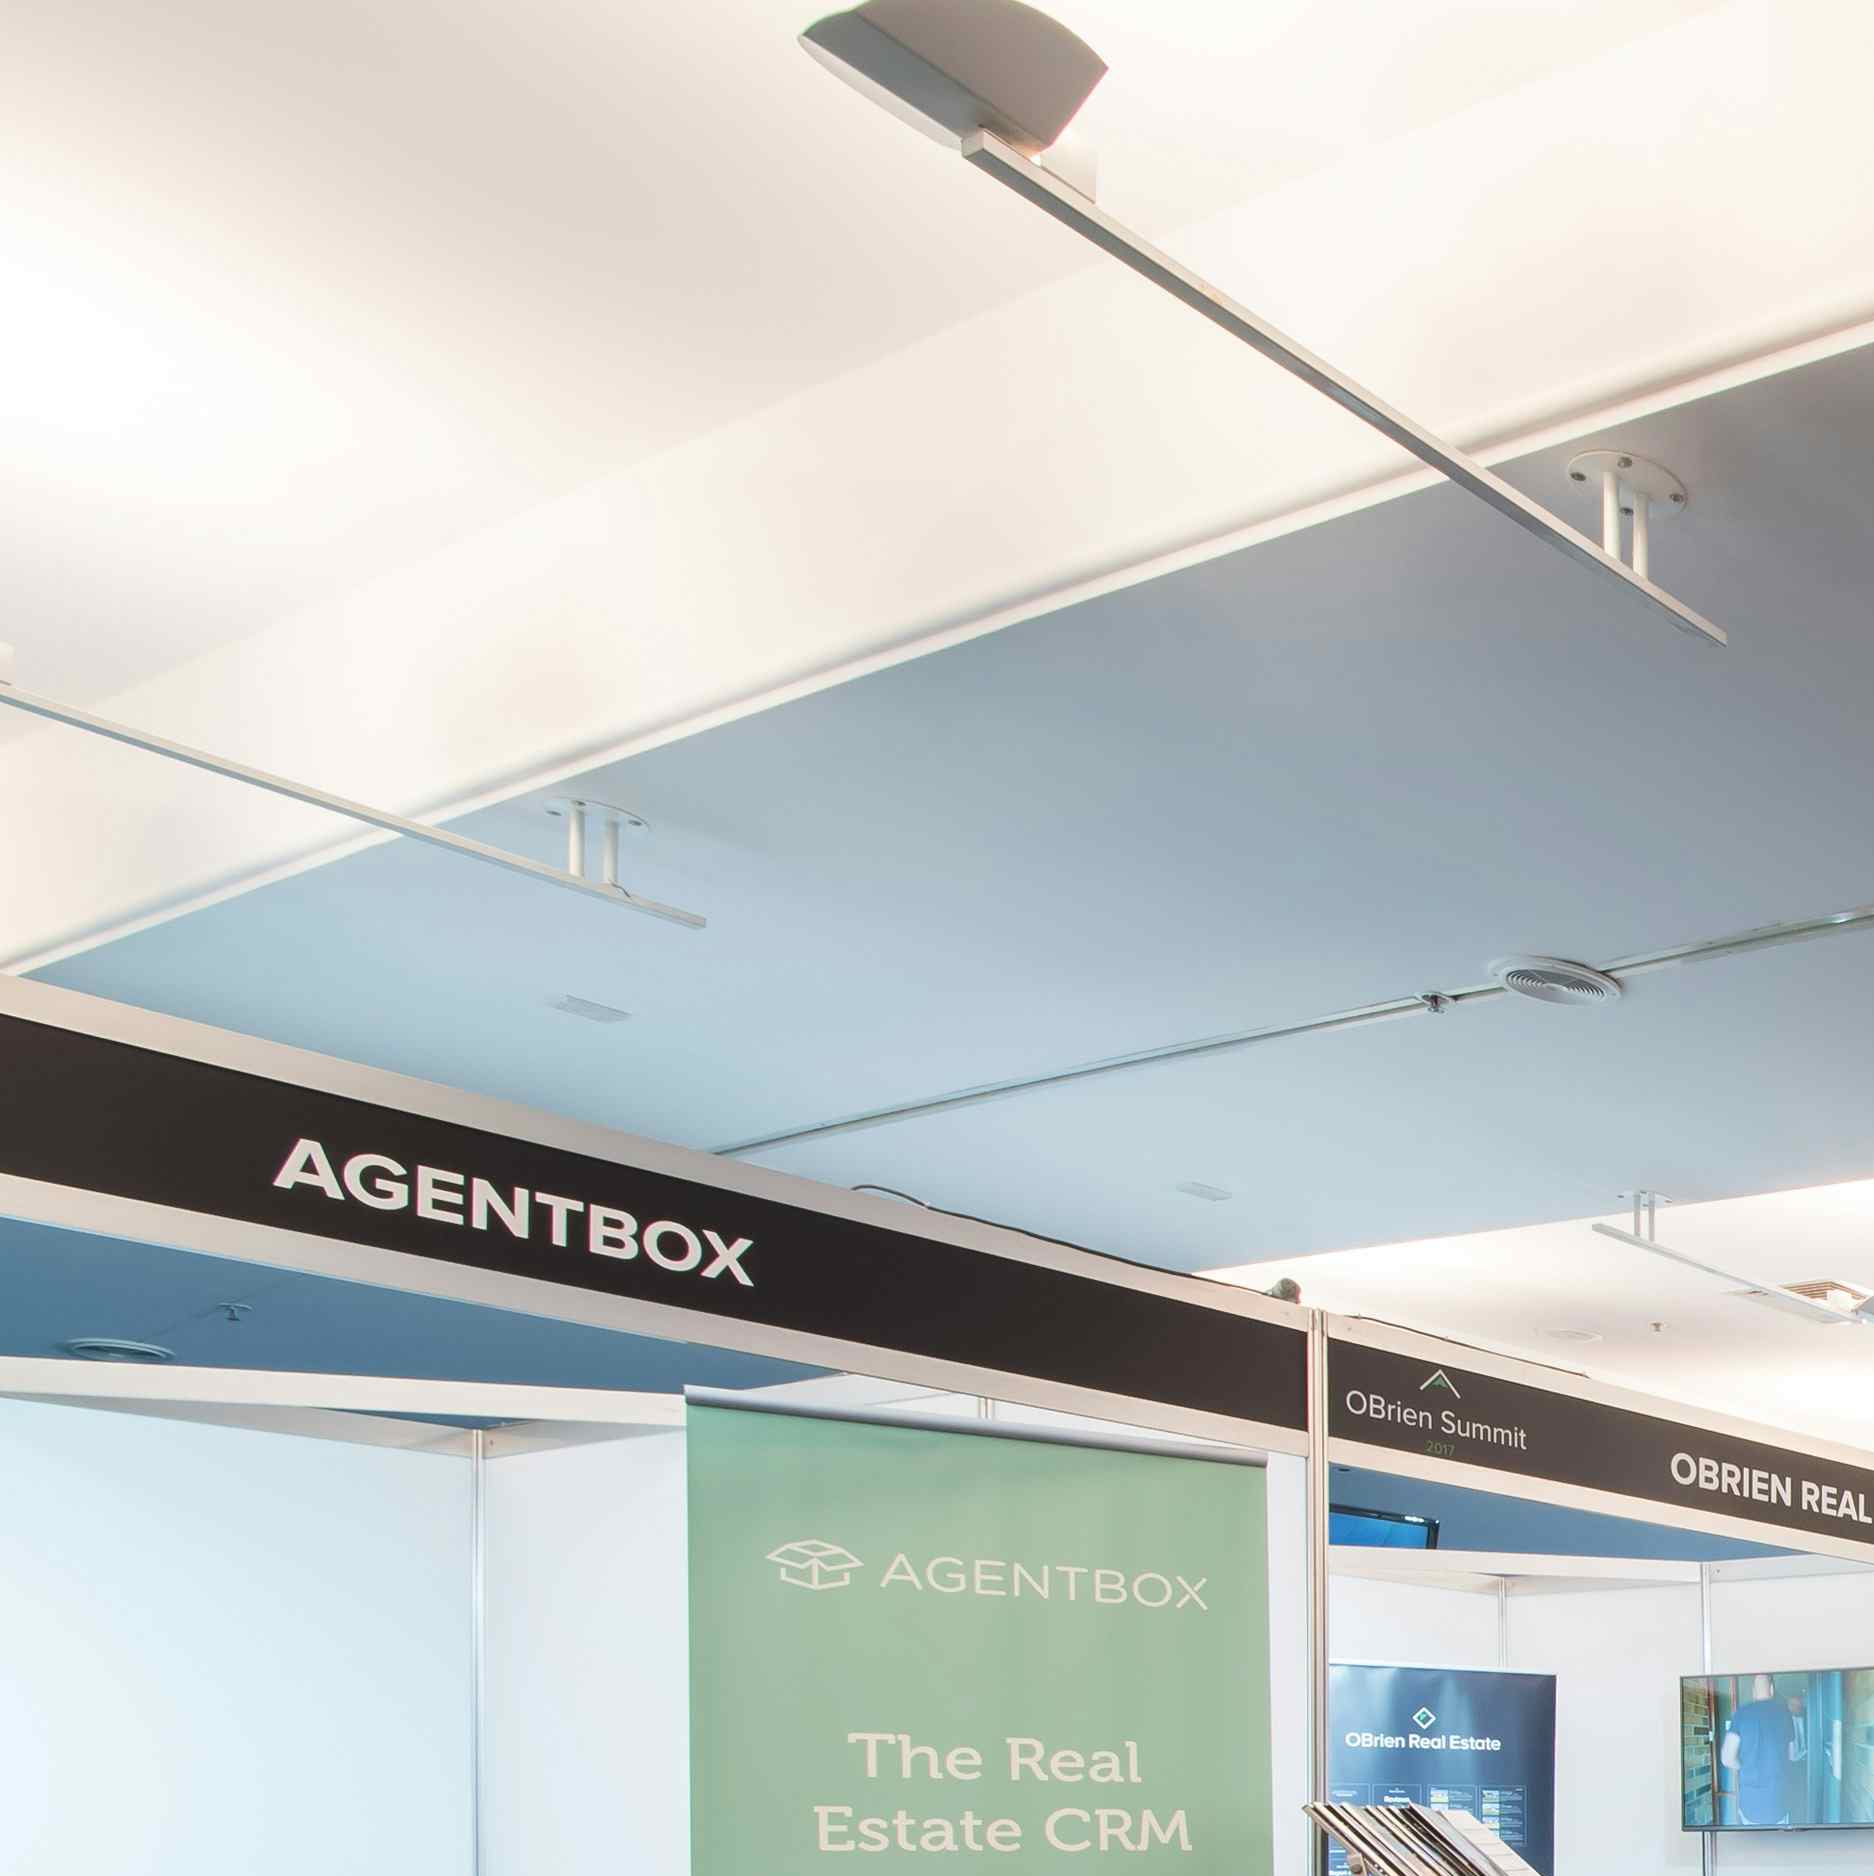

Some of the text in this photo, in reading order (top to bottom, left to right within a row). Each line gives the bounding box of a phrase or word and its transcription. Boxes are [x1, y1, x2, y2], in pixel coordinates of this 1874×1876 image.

[272, 1137, 755, 1287] AGENTBOX
[1346, 1390, 1527, 1450] OBrien Summit
[1426, 1440, 1455, 1455] 2017
[1670, 1452, 1792, 1508] OBRIEN
[1801, 1481, 1872, 1524] REAL
[880, 1551, 1208, 1611] AGENTBOX
[848, 1732, 1143, 1784] The Real
[1345, 1732, 1501, 1751] OBrien Real Estate
[814, 1805, 1193, 1852] Estate CRM
